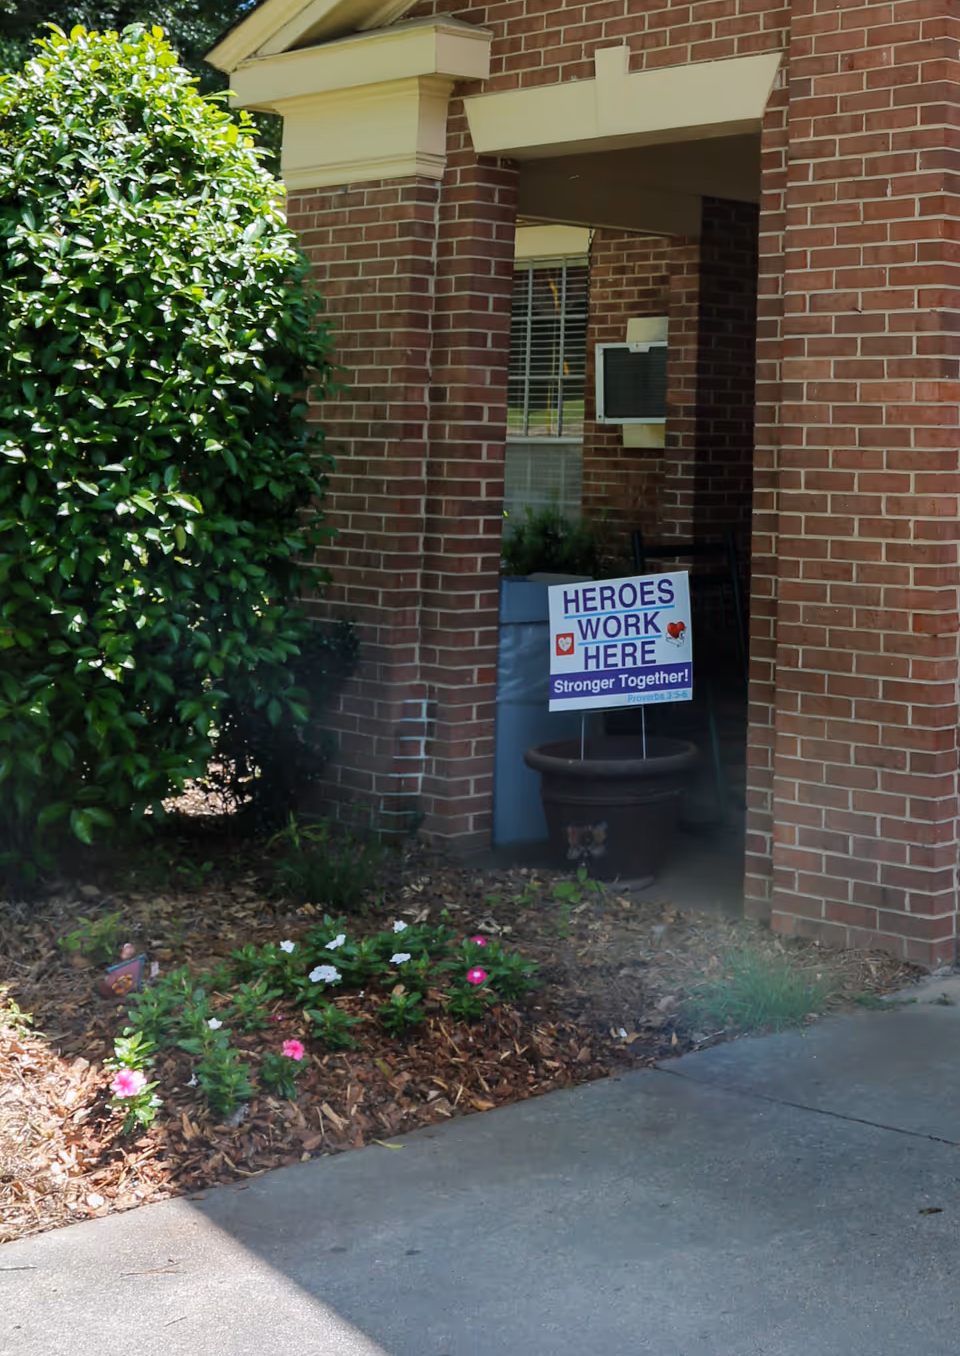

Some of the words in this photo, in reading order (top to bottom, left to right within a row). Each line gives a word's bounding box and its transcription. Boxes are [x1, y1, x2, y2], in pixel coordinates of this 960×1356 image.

[563, 579, 675, 614] HEROES
[577, 611, 662, 641] WORK
[584, 640, 657, 670] HERE
[554, 677, 615, 693] Stronger
[618, 669, 689, 689] Together!
